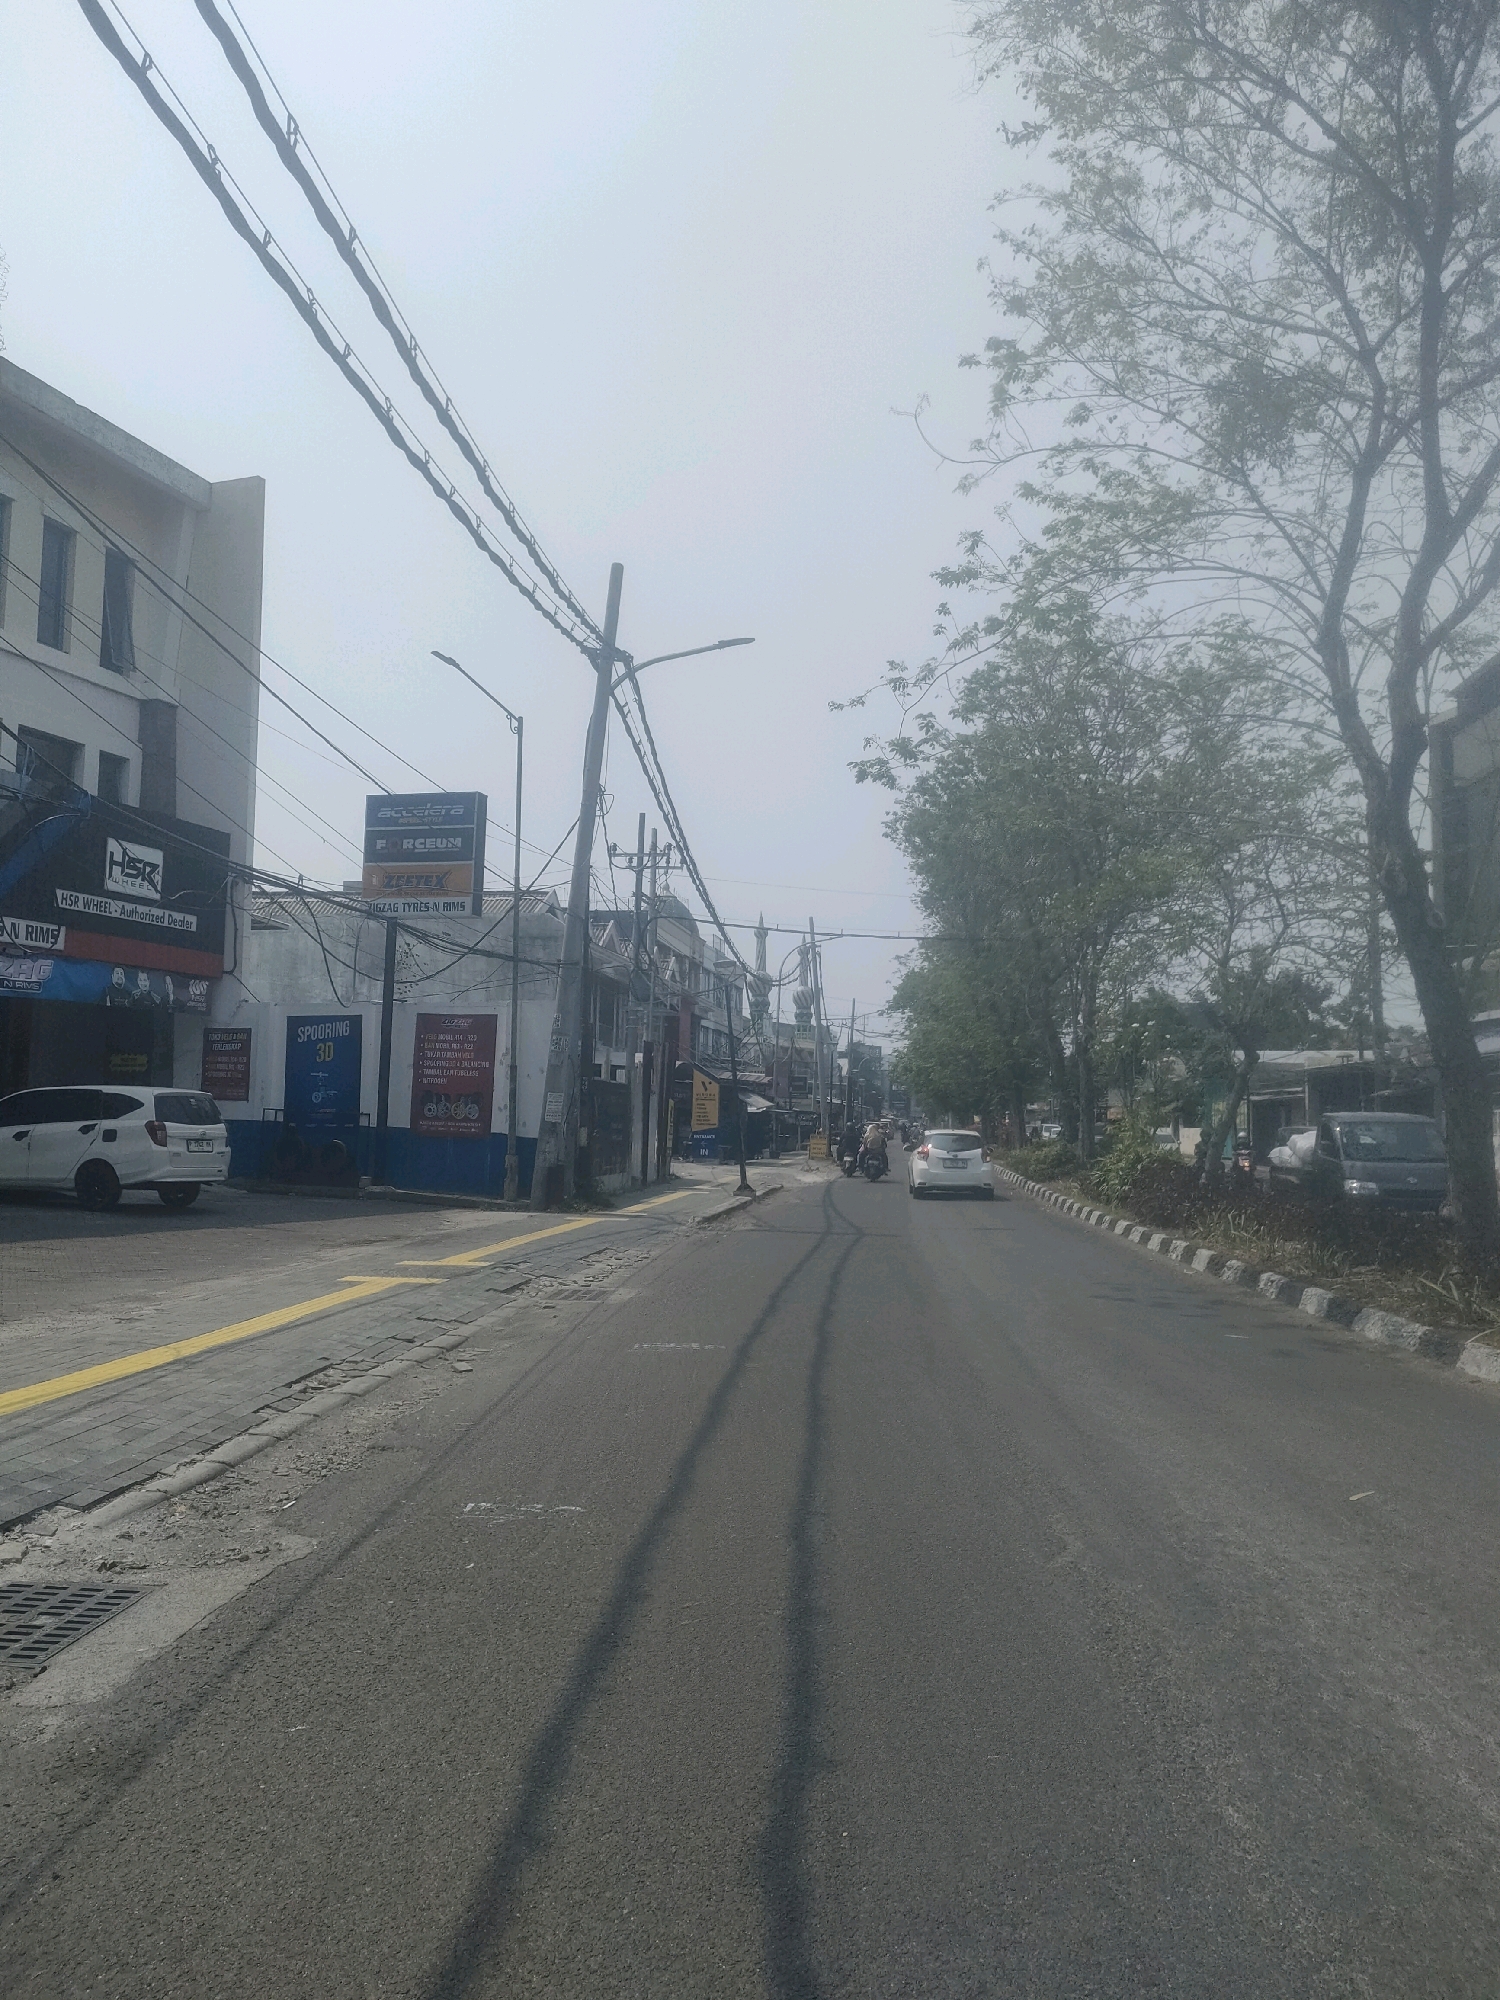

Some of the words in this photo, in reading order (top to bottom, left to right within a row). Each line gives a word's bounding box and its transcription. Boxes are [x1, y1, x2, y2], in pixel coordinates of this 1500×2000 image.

[108, 849, 161, 894] HSR
[382, 871, 450, 888] ZEETEX
[60, 892, 80, 909] HSR
[82, 896, 113, 915] WHEEL
[120, 904, 165, 925] Authorized
[167, 913, 193, 930] Dealer
[368, 902, 399, 913] ZIGZAG
[402, 901, 430, 913] TYRES
[443, 901, 465, 912] RIMS
[10, 921, 20, 940] N
[25, 923, 59, 945] RIMS
[297, 1020, 350, 1043] SPOORING
[316, 1042, 334, 1062] 3D
[700, 1148, 709, 1156] IN
